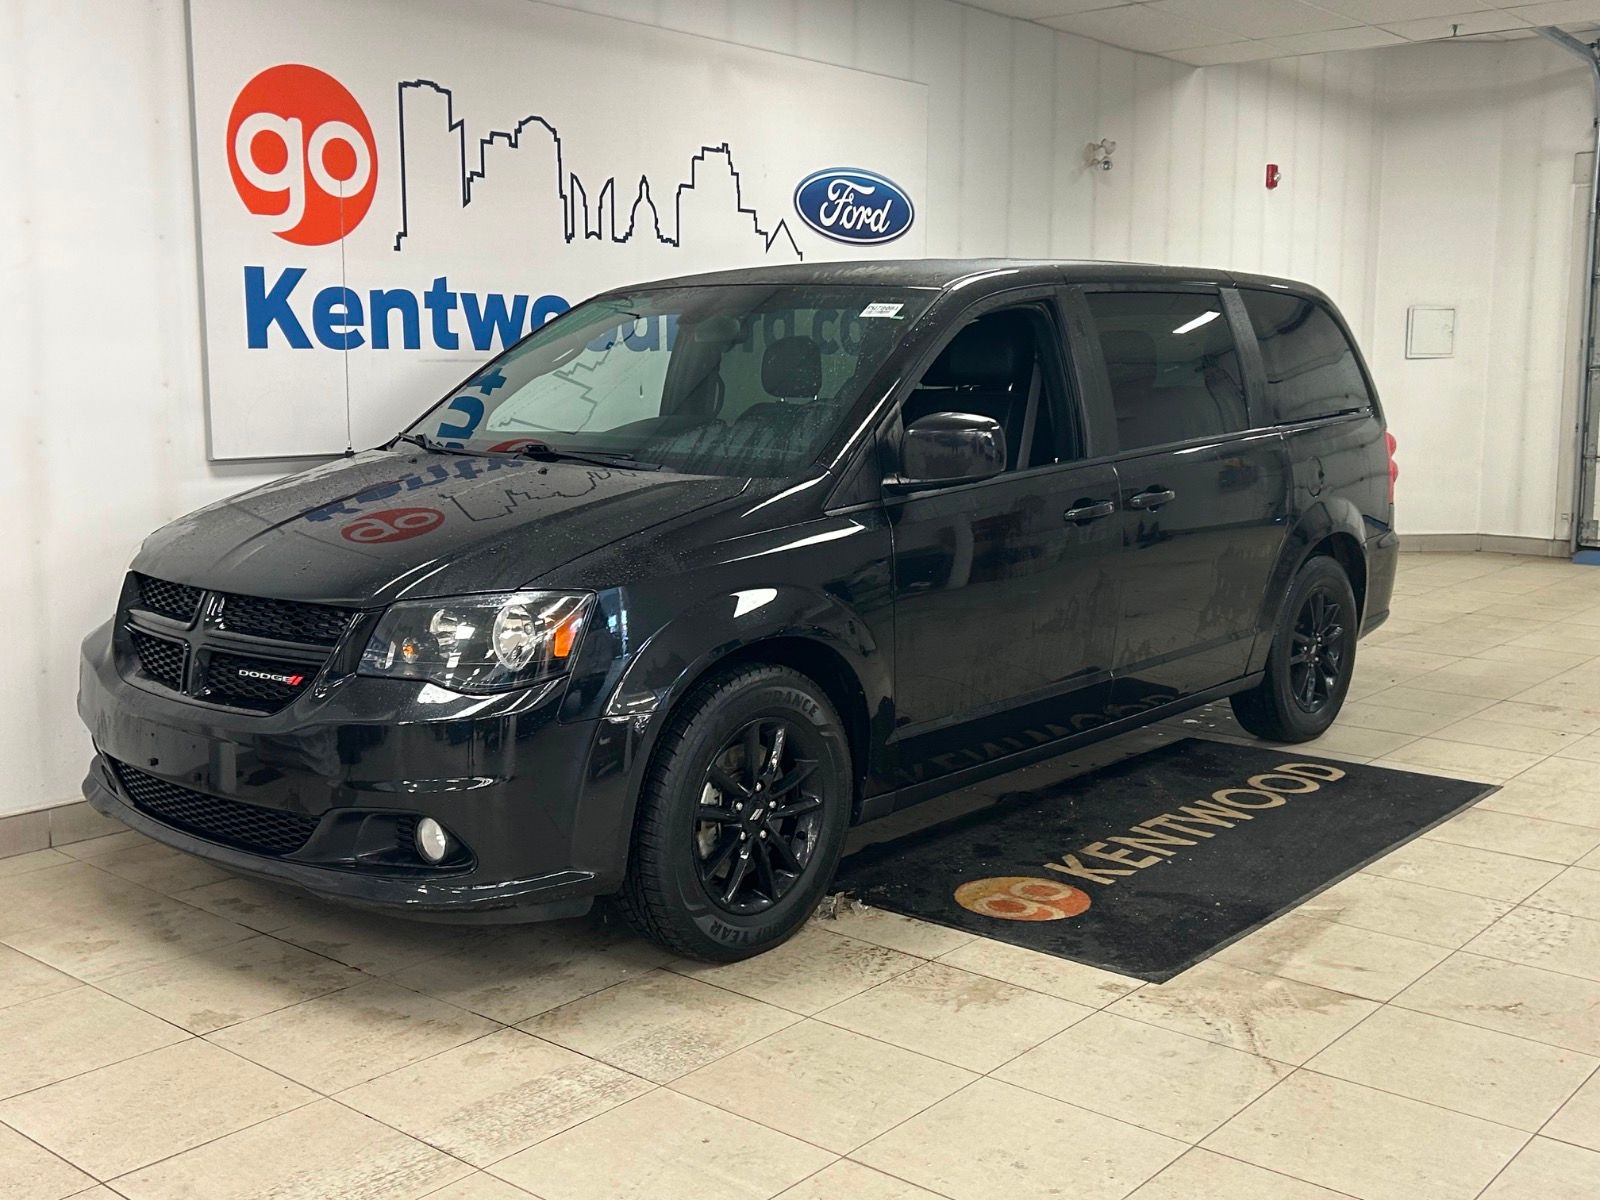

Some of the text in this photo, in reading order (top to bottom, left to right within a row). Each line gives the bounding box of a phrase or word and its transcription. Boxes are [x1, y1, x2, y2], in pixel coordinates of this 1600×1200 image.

[235, 111, 371, 232] go
[819, 178, 893, 233] Ford
[238, 669, 291, 683] DODGE
[1043, 763, 1347, 885] KENTWOOD
